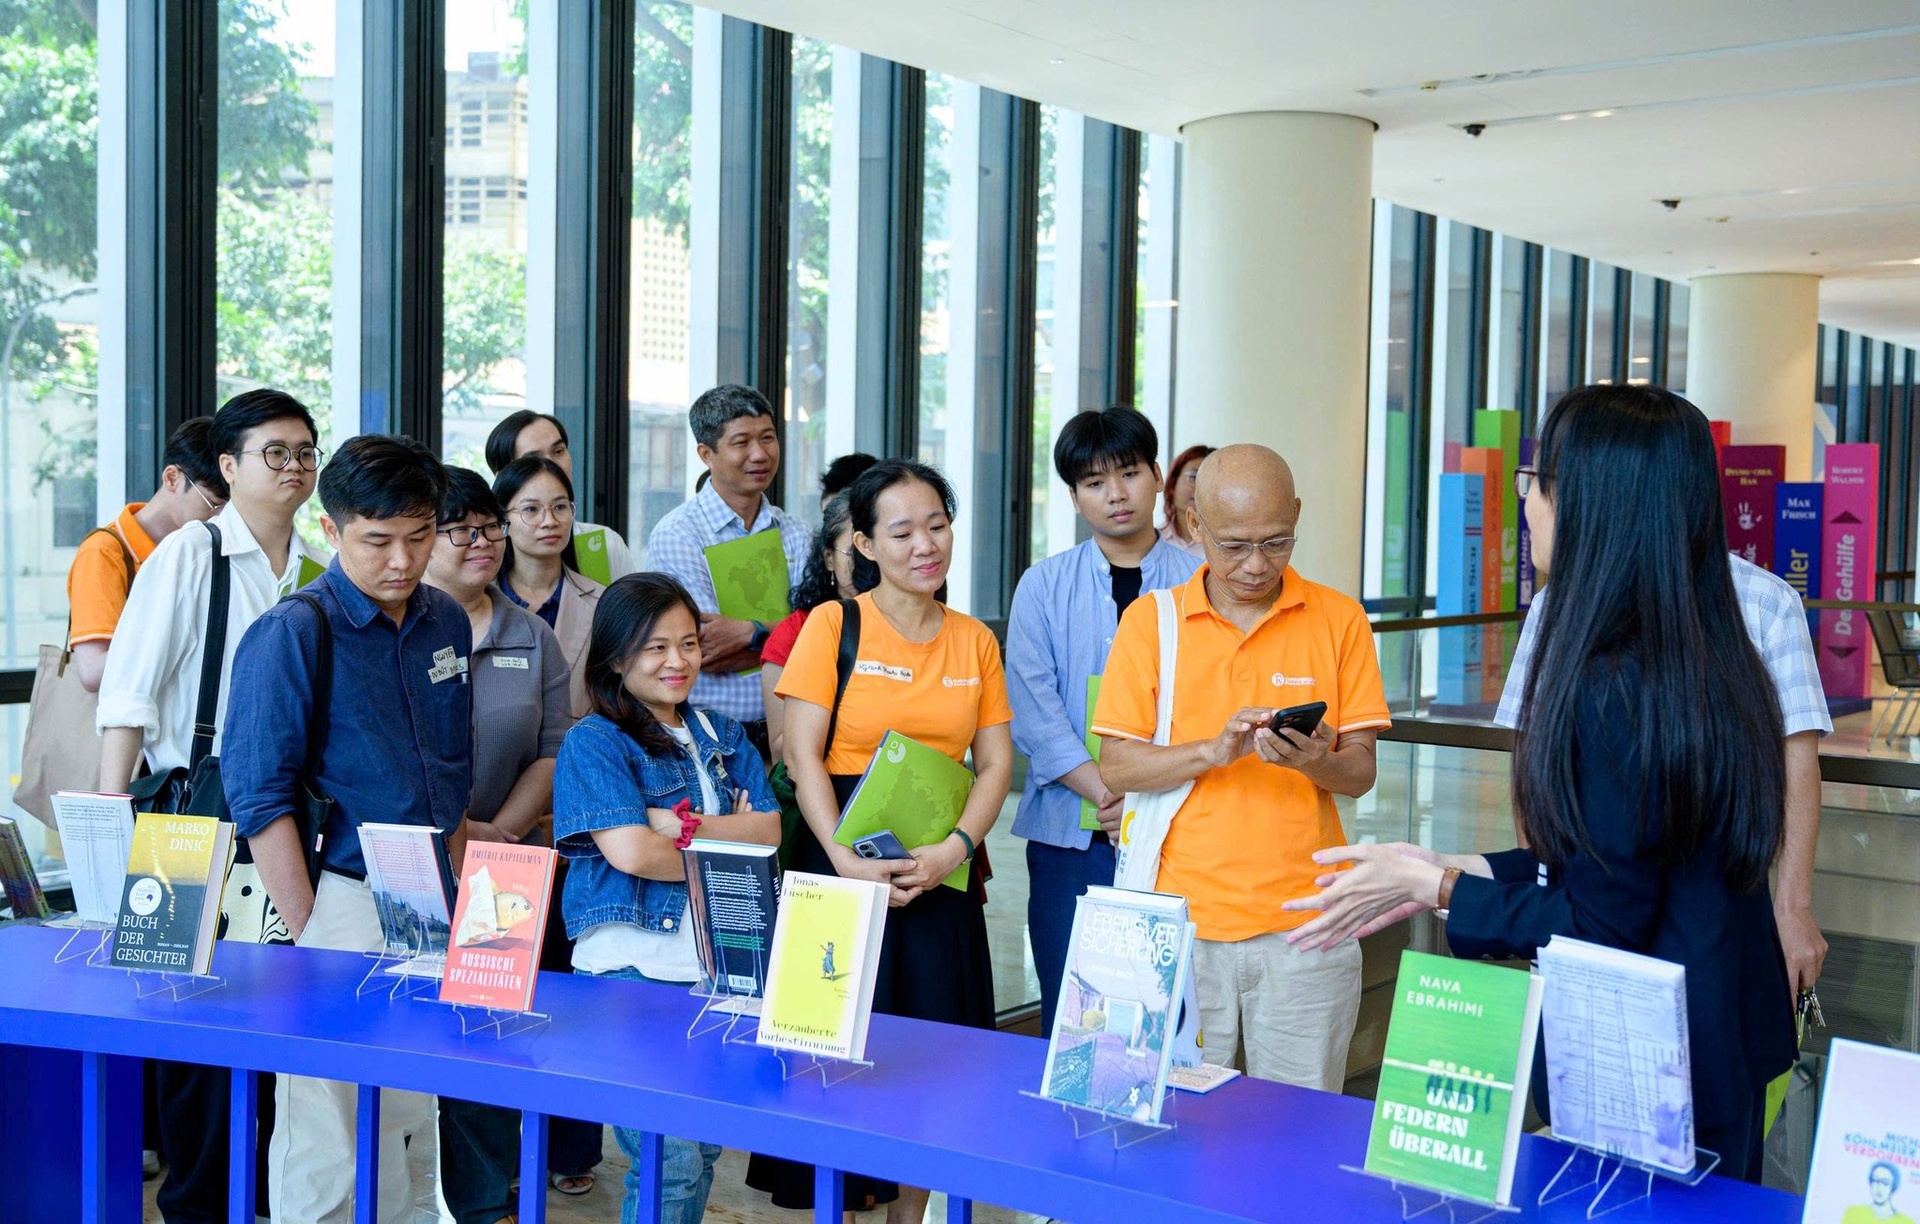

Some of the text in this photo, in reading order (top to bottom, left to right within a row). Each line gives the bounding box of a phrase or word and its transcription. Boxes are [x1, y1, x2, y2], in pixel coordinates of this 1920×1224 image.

[1832, 466, 1863, 474] ROBERT
[1740, 477, 1757, 485] HAN
[1831, 476, 1864, 484] WALSER
[1788, 498, 1811, 508] MAX
[1782, 510, 1816, 520] FRISCH
[1834, 534, 1855, 636] De Gehülfe
[165, 821, 210, 837] MARKO
[170, 836, 208, 852] DINIĆ
[793, 876, 819, 887] Jonas
[784, 887, 824, 900] Lüscher
[122, 915, 158, 930] BUCH
[118, 931, 145, 946] DER
[116, 948, 188, 966] GESICHTER
[1080, 930, 1175, 967] SICHERUNG
[461, 952, 516, 972] RUSSISCHE
[449, 968, 522, 990] SPEZIALITÄTEN
[1419, 974, 1461, 994] NAVA
[1406, 990, 1483, 1018] EBRAHIMI
[772, 1019, 837, 1037] Verzauberte
[760, 1030, 846, 1054] Vorbestimmung
[1426, 1086, 1475, 1114] UND
[1382, 1100, 1469, 1139] FEDERN
[1389, 1124, 1488, 1171] ÜBERALL
[1844, 1132, 1916, 1157] KÖHLMEIER
[1886, 1132, 1920, 1148] MICH
